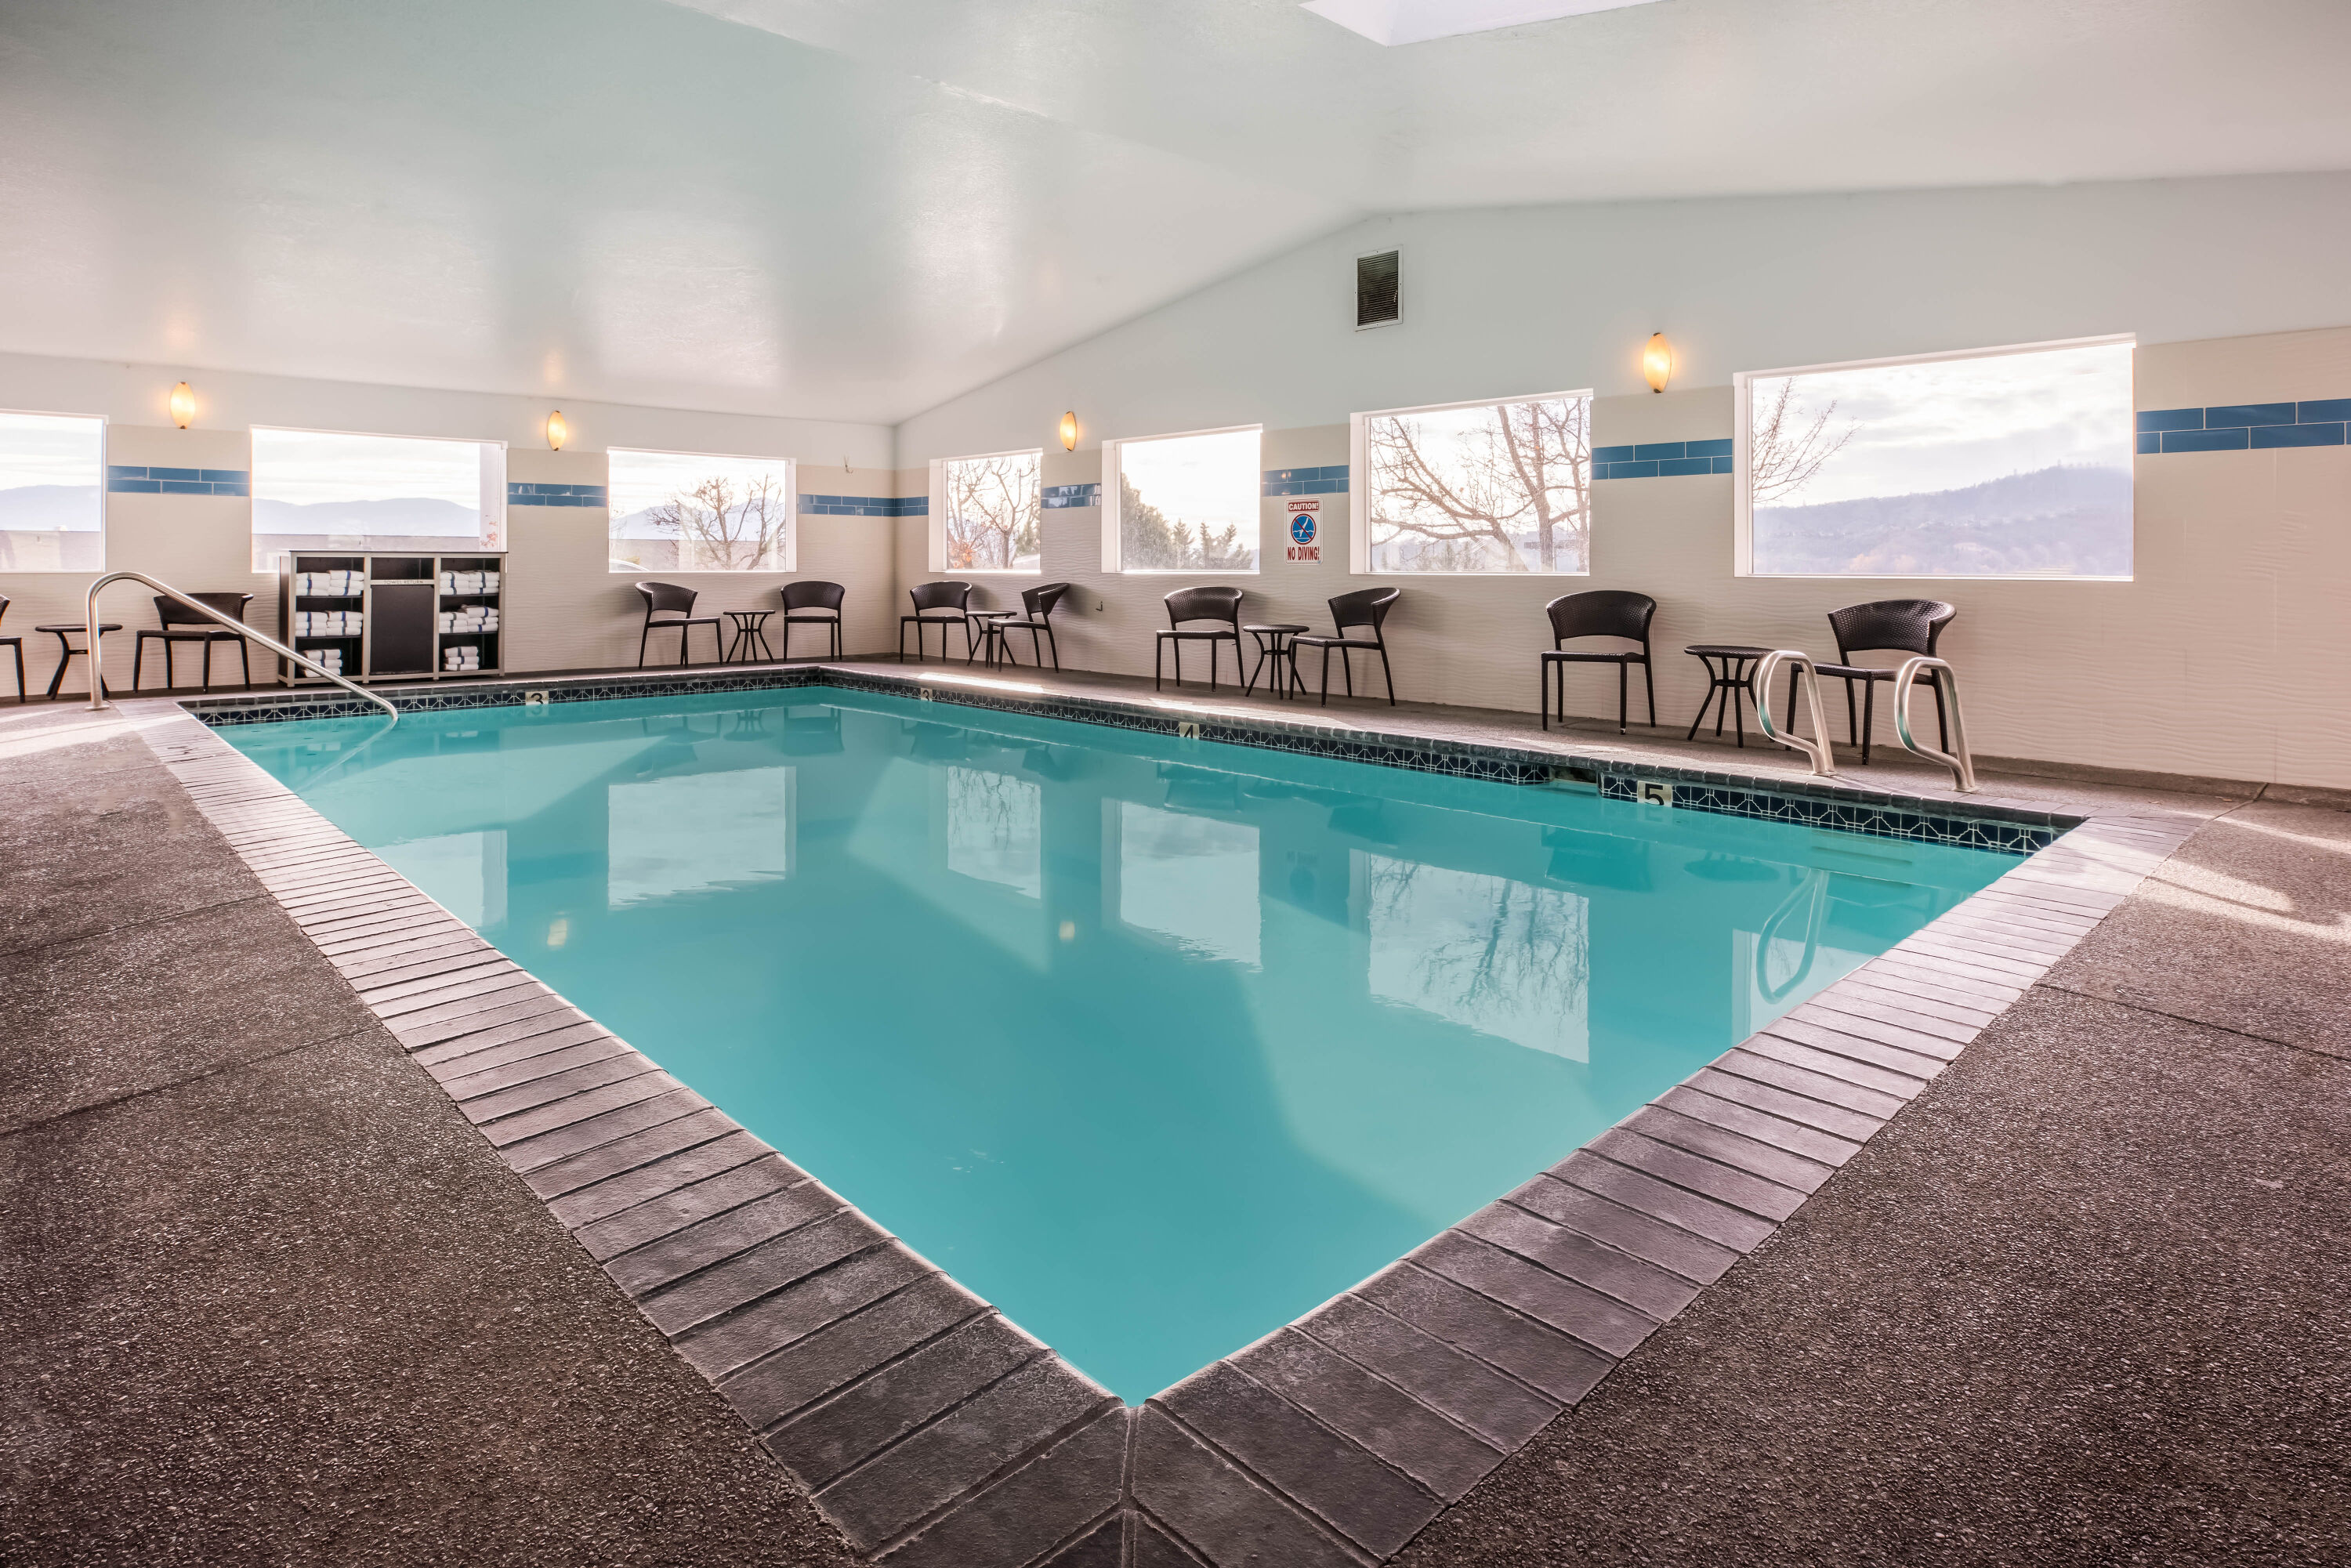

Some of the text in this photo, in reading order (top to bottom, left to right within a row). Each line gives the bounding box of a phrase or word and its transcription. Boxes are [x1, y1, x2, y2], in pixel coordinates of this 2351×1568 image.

[1288, 502, 1319, 511] CAUTION!
[1287, 546, 1320, 560] NO DIVING!
[1645, 783, 1665, 806] 5
